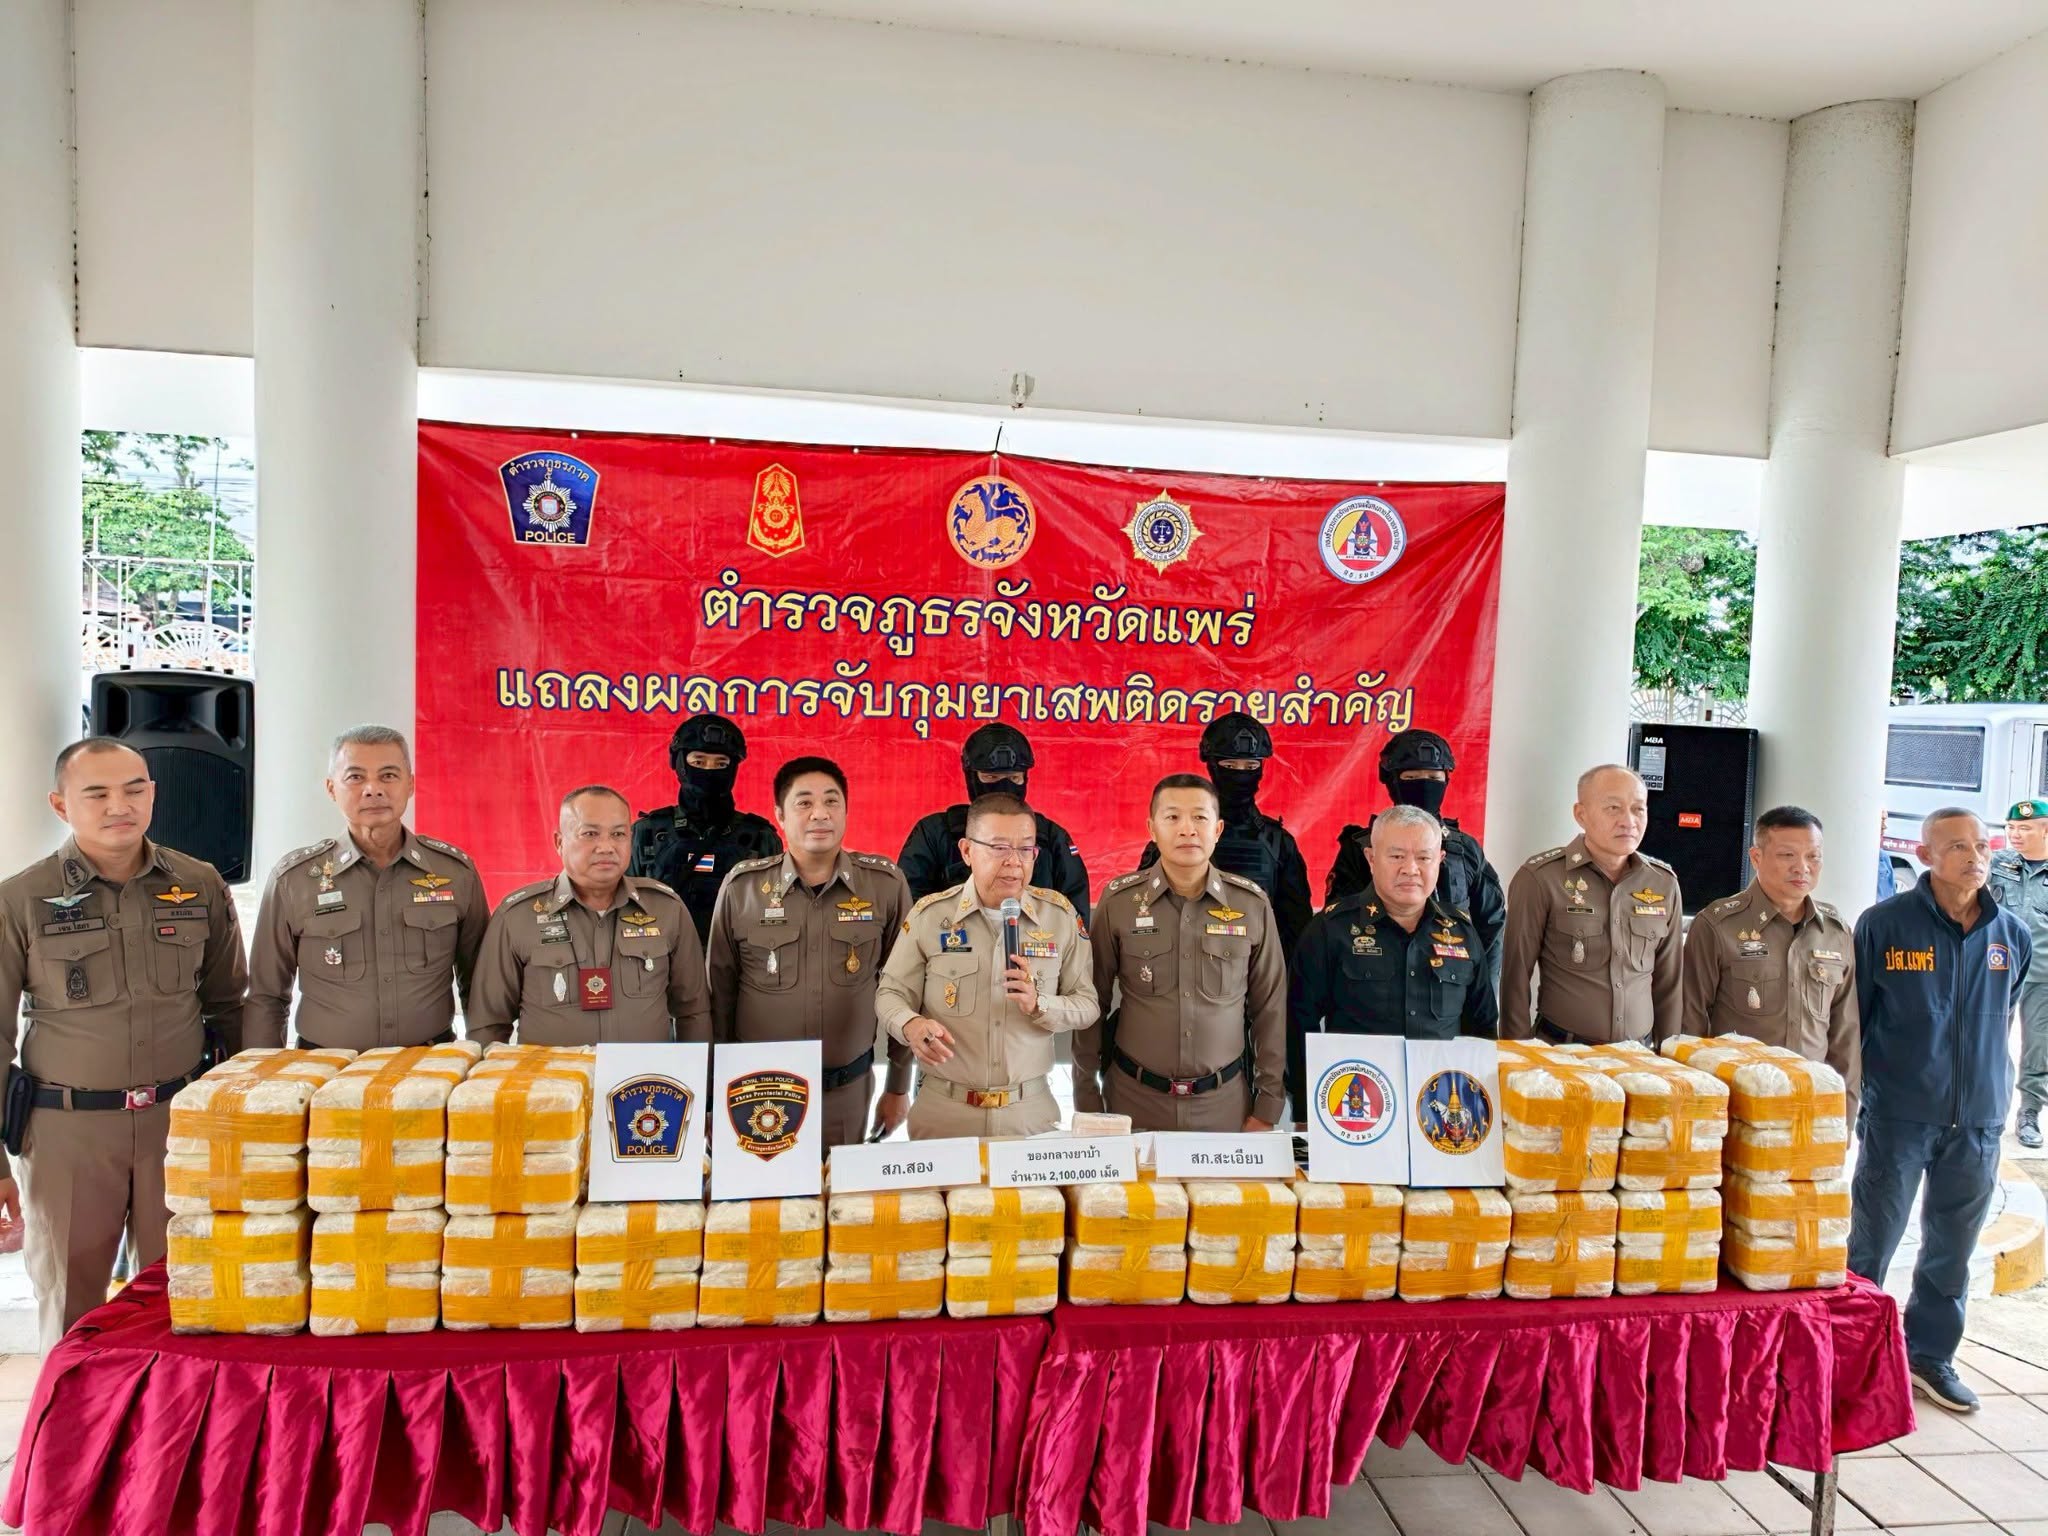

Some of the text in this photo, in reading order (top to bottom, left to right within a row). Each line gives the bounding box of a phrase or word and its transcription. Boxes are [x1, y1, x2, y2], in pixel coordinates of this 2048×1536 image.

[508, 459, 590, 482] ตำรวจภูธรภาค
[525, 530, 576, 544] POLICE
[703, 568, 1256, 657] ตำรวจภูธรจังหวัดแพร่
[499, 660, 1414, 734] แถลงผลการจับกุมยาเสพติดรายสำคัญ
[1644, 736, 1664, 744] MBA
[1885, 945, 1935, 972] ปส.แพร่
[741, 1078, 759, 1086] ROYAL
[774, 1076, 796, 1084] POLICE
[619, 1084, 684, 1102] ตำรวจภูธรภาค
[753, 1090, 783, 1098] Provincial
[784, 1091, 802, 1100] Police
[627, 1145, 669, 1155] POLICE
[1027, 1145, 1101, 1161] ของกลางยาบ้า
[881, 1160, 934, 1176] สภ.สอง
[1011, 1164, 1120, 1182] จำนวน 2,100,000 เม็ด
